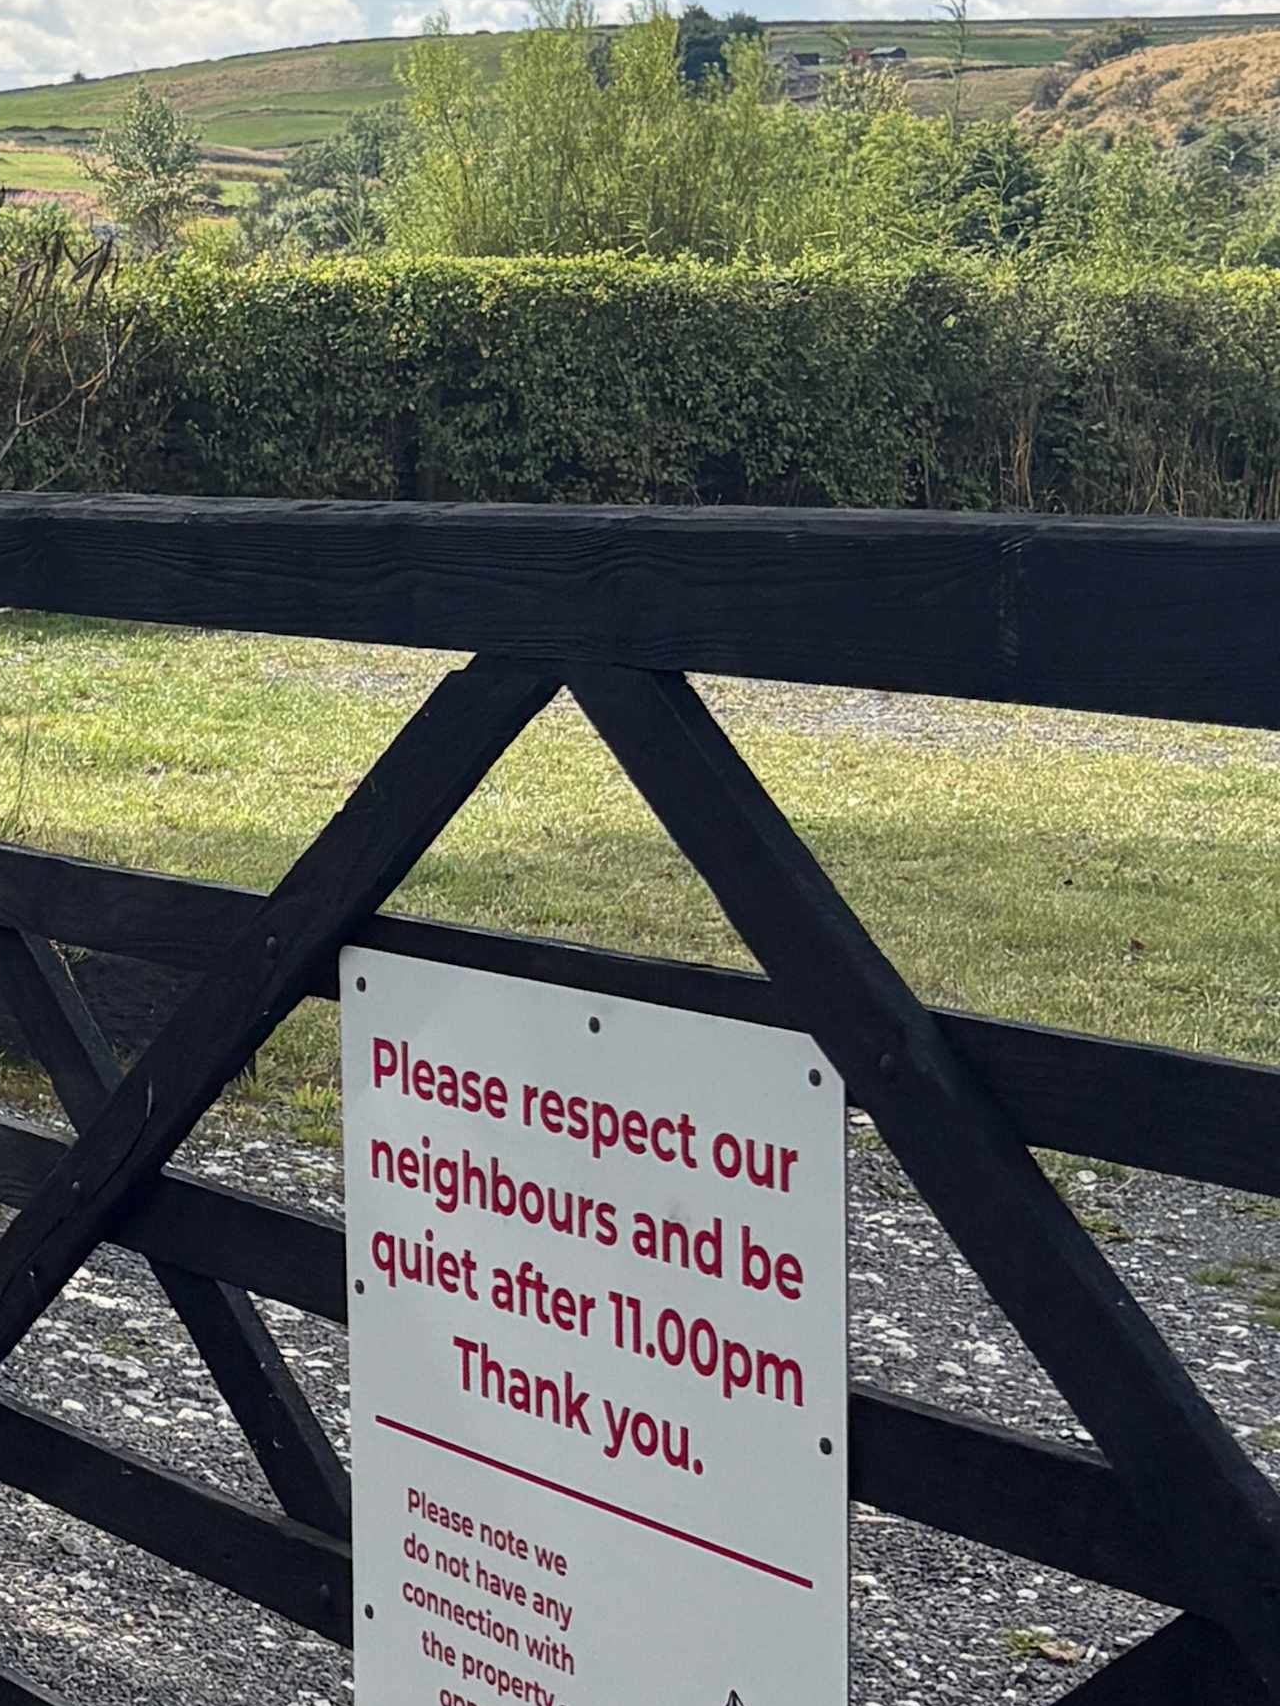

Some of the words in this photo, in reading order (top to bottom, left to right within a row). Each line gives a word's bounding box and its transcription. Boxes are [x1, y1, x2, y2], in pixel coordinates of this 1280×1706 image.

[372, 1037, 508, 1119] Please
[523, 1083, 697, 1169] respect
[712, 1133, 798, 1192] our
[371, 1136, 618, 1246] neighbours
[632, 1212, 722, 1279] and
[741, 1225, 804, 1300] be
[372, 1230, 478, 1301] quiet
[491, 1261, 596, 1336] after
[609, 1291, 804, 1406] 11.00pm
[453, 1336, 591, 1435] Thank
[604, 1399, 704, 1475] you.
[403, 1533, 429, 1566] do
[435, 1552, 470, 1583] not
[476, 1564, 526, 1606] have
[533, 1590, 573, 1631] any
[408, 1488, 474, 1538] Please
[480, 1521, 528, 1560] note
[534, 1542, 568, 1577] we
[402, 1581, 520, 1652] connection
[525, 1637, 575, 1676] with
[421, 1631, 456, 1668] the
